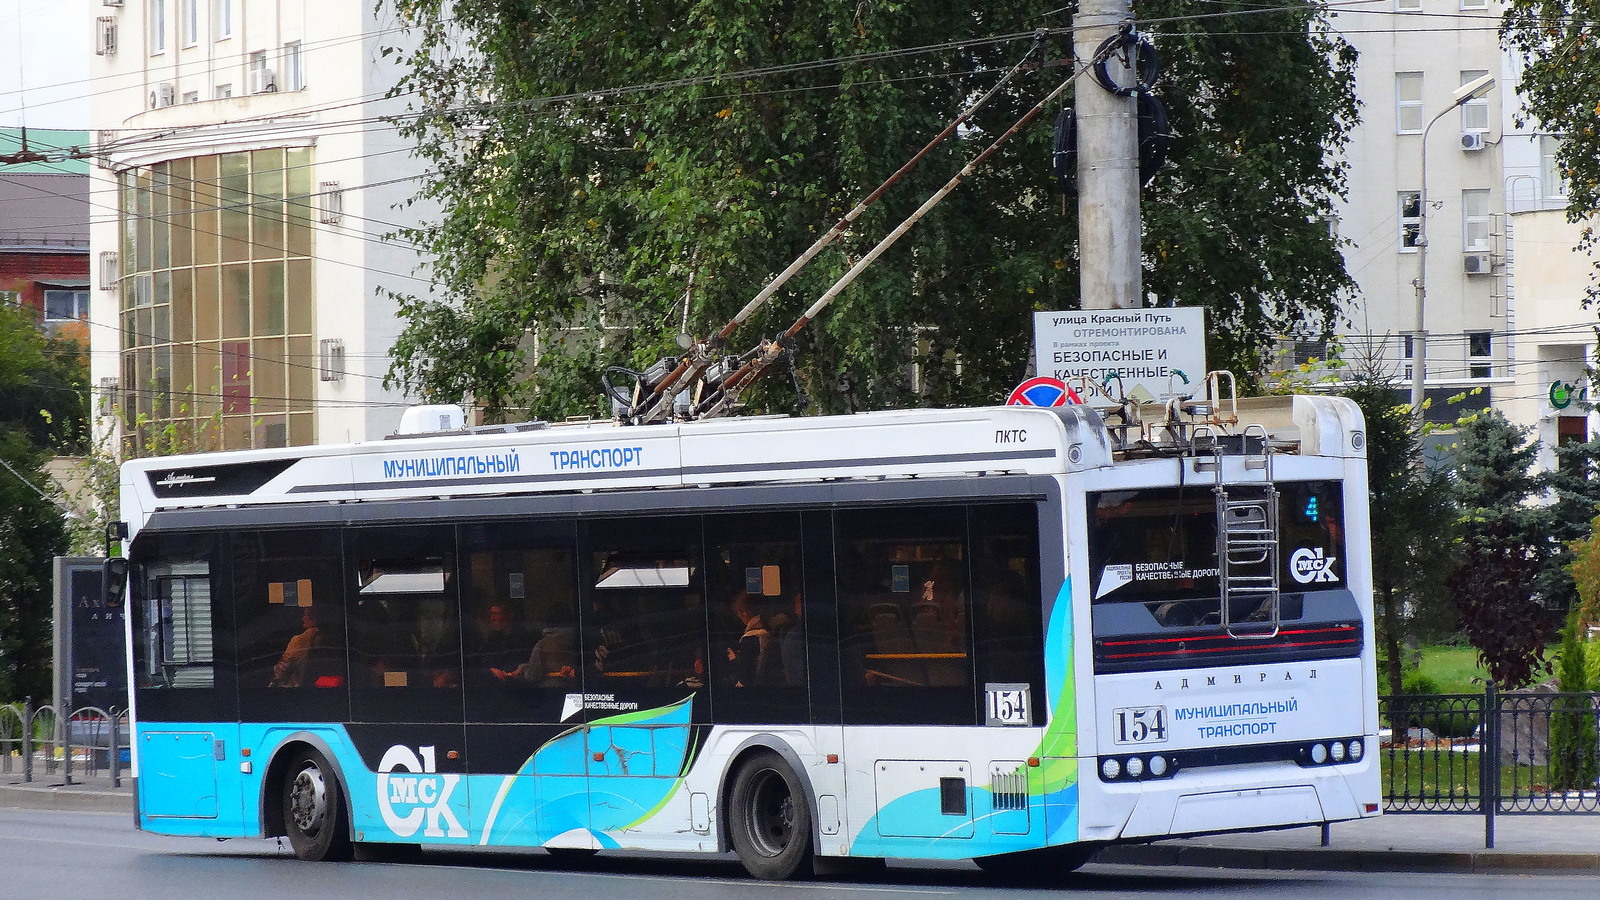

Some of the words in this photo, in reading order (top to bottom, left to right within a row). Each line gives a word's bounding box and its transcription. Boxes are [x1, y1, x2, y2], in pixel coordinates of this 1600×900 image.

[1052, 316, 1087, 326] улица
[1091, 312, 1142, 326] Красный
[1145, 313, 1172, 325] Путь
[1073, 326, 1187, 338] ОТРЕМОНТИРОВАНА
[1089, 340, 1120, 348] проекта
[1053, 350, 1154, 363] БЕЗОПАСНЫЕ
[1158, 349, 1168, 361] И
[995, 429, 1027, 443] ПКТС
[383, 447, 520, 479] МУНИЦИПАЛЬНЫЙ
[550, 446, 643, 470] ТРАНСПОРТ
[1304, 496, 1319, 521] 4
[1135, 561, 1184, 572] БЕЗОПАСНЫЕ
[1154, 669, 1318, 690] АДМИРАЛ
[992, 690, 1026, 720] 154
[1175, 696, 1298, 721] МУНИЦИПАЛЬНЫЙ
[1117, 709, 1167, 743] 154
[1197, 721, 1277, 739] ТРАНСПОРТ
